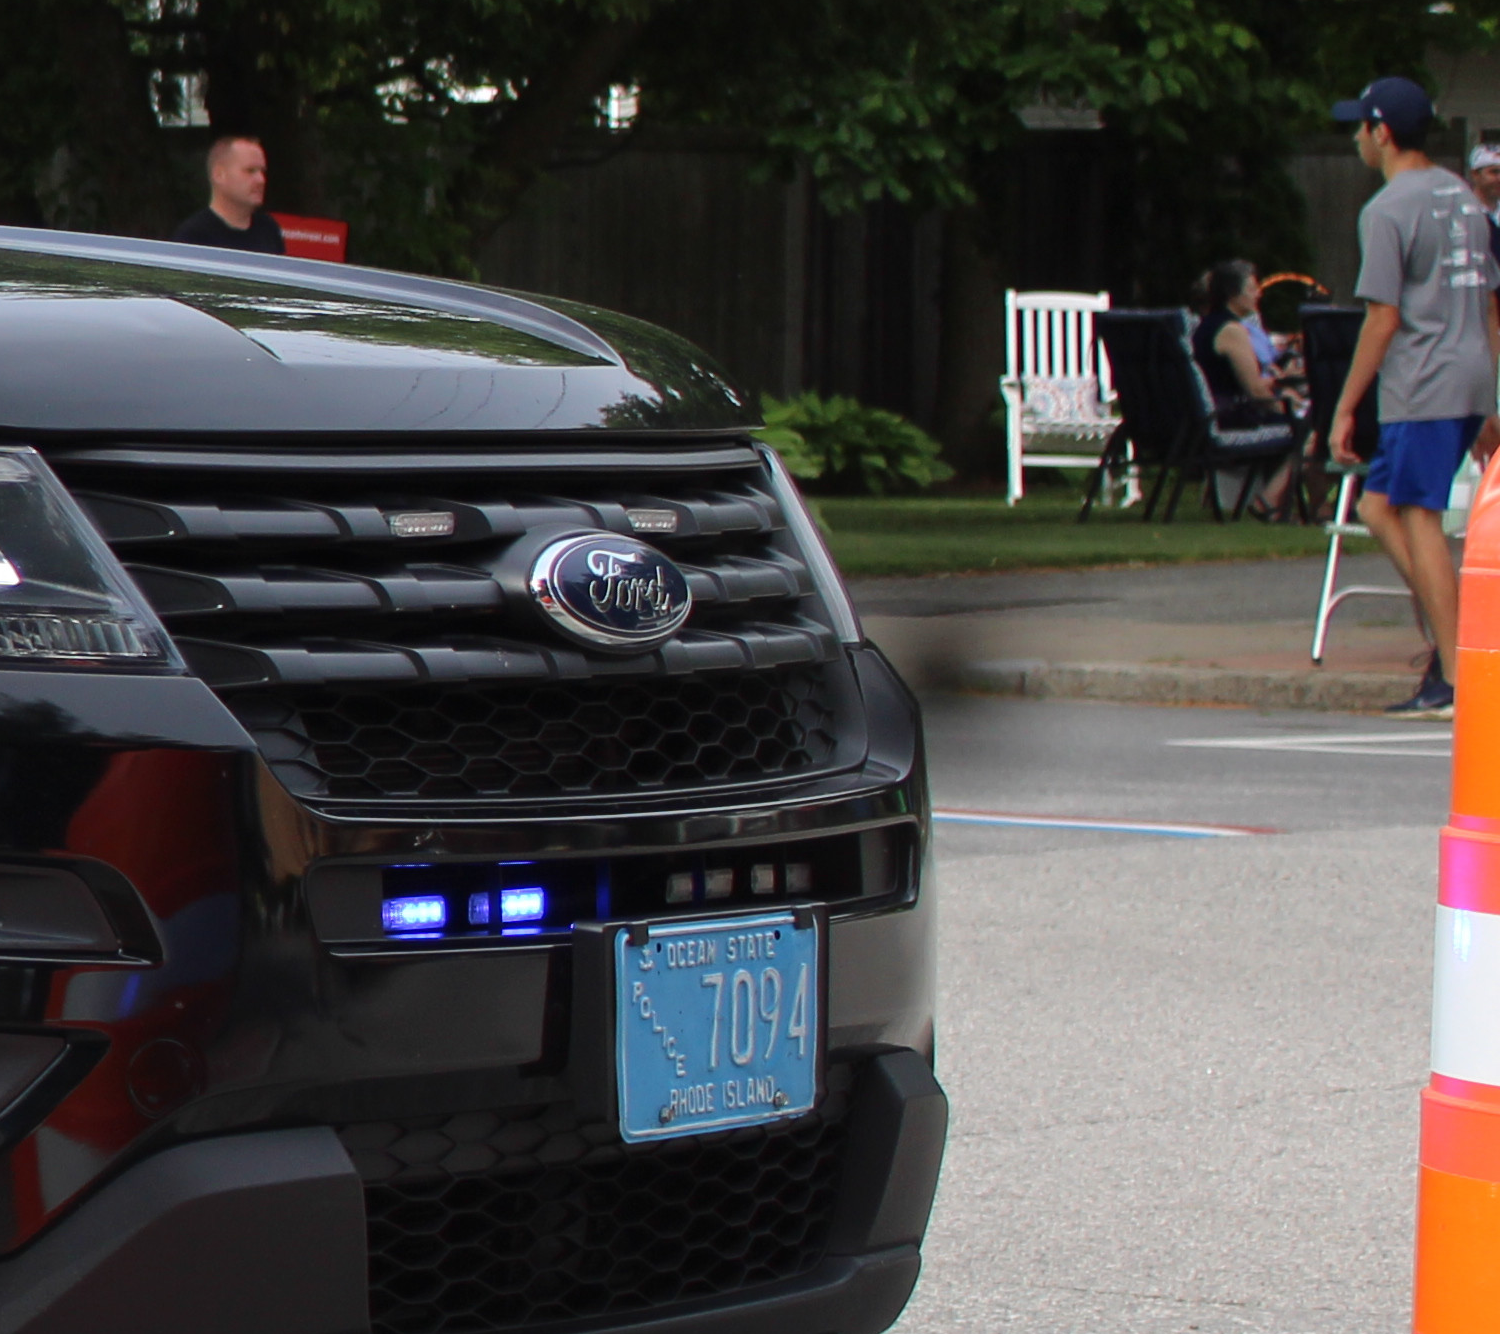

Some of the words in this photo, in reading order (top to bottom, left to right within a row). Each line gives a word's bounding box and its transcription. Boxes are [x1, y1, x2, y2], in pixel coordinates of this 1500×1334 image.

[586, 549, 671, 613] Ford
[667, 938, 715, 969] OCEAN
[727, 931, 775, 962] STATE
[632, 981, 687, 1078] POLICE
[701, 962, 807, 1072] 7094
[669, 1082, 715, 1117] RHODE
[722, 1075, 776, 1109] ISLAND
